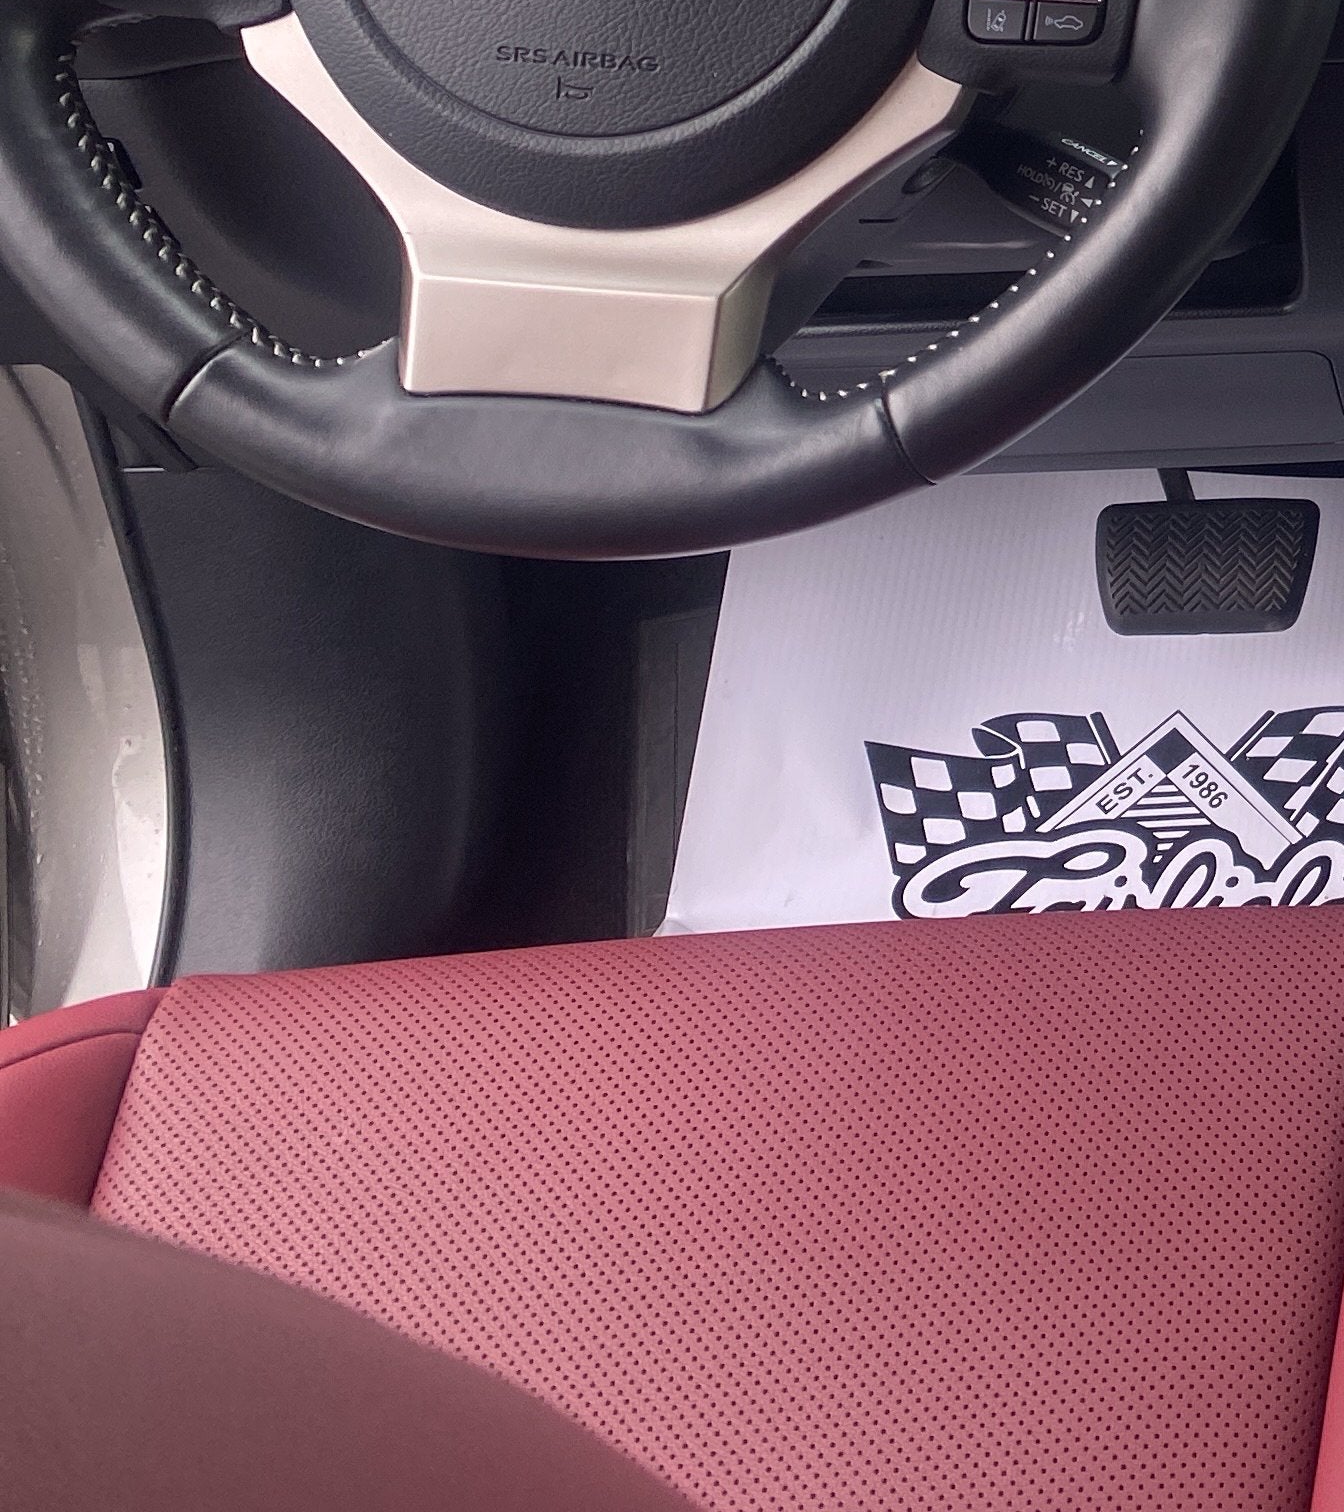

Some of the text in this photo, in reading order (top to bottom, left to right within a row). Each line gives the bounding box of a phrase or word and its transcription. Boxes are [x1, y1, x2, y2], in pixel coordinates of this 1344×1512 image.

[495, 45, 660, 72] SRS AIRBAG
[1061, 138, 1108, 164] CANCEL
[1017, 164, 1043, 183] HOLD
[1058, 161, 1085, 183] RES
[1041, 197, 1068, 217] SET
[1096, 762, 1230, 816] EST. 1986
